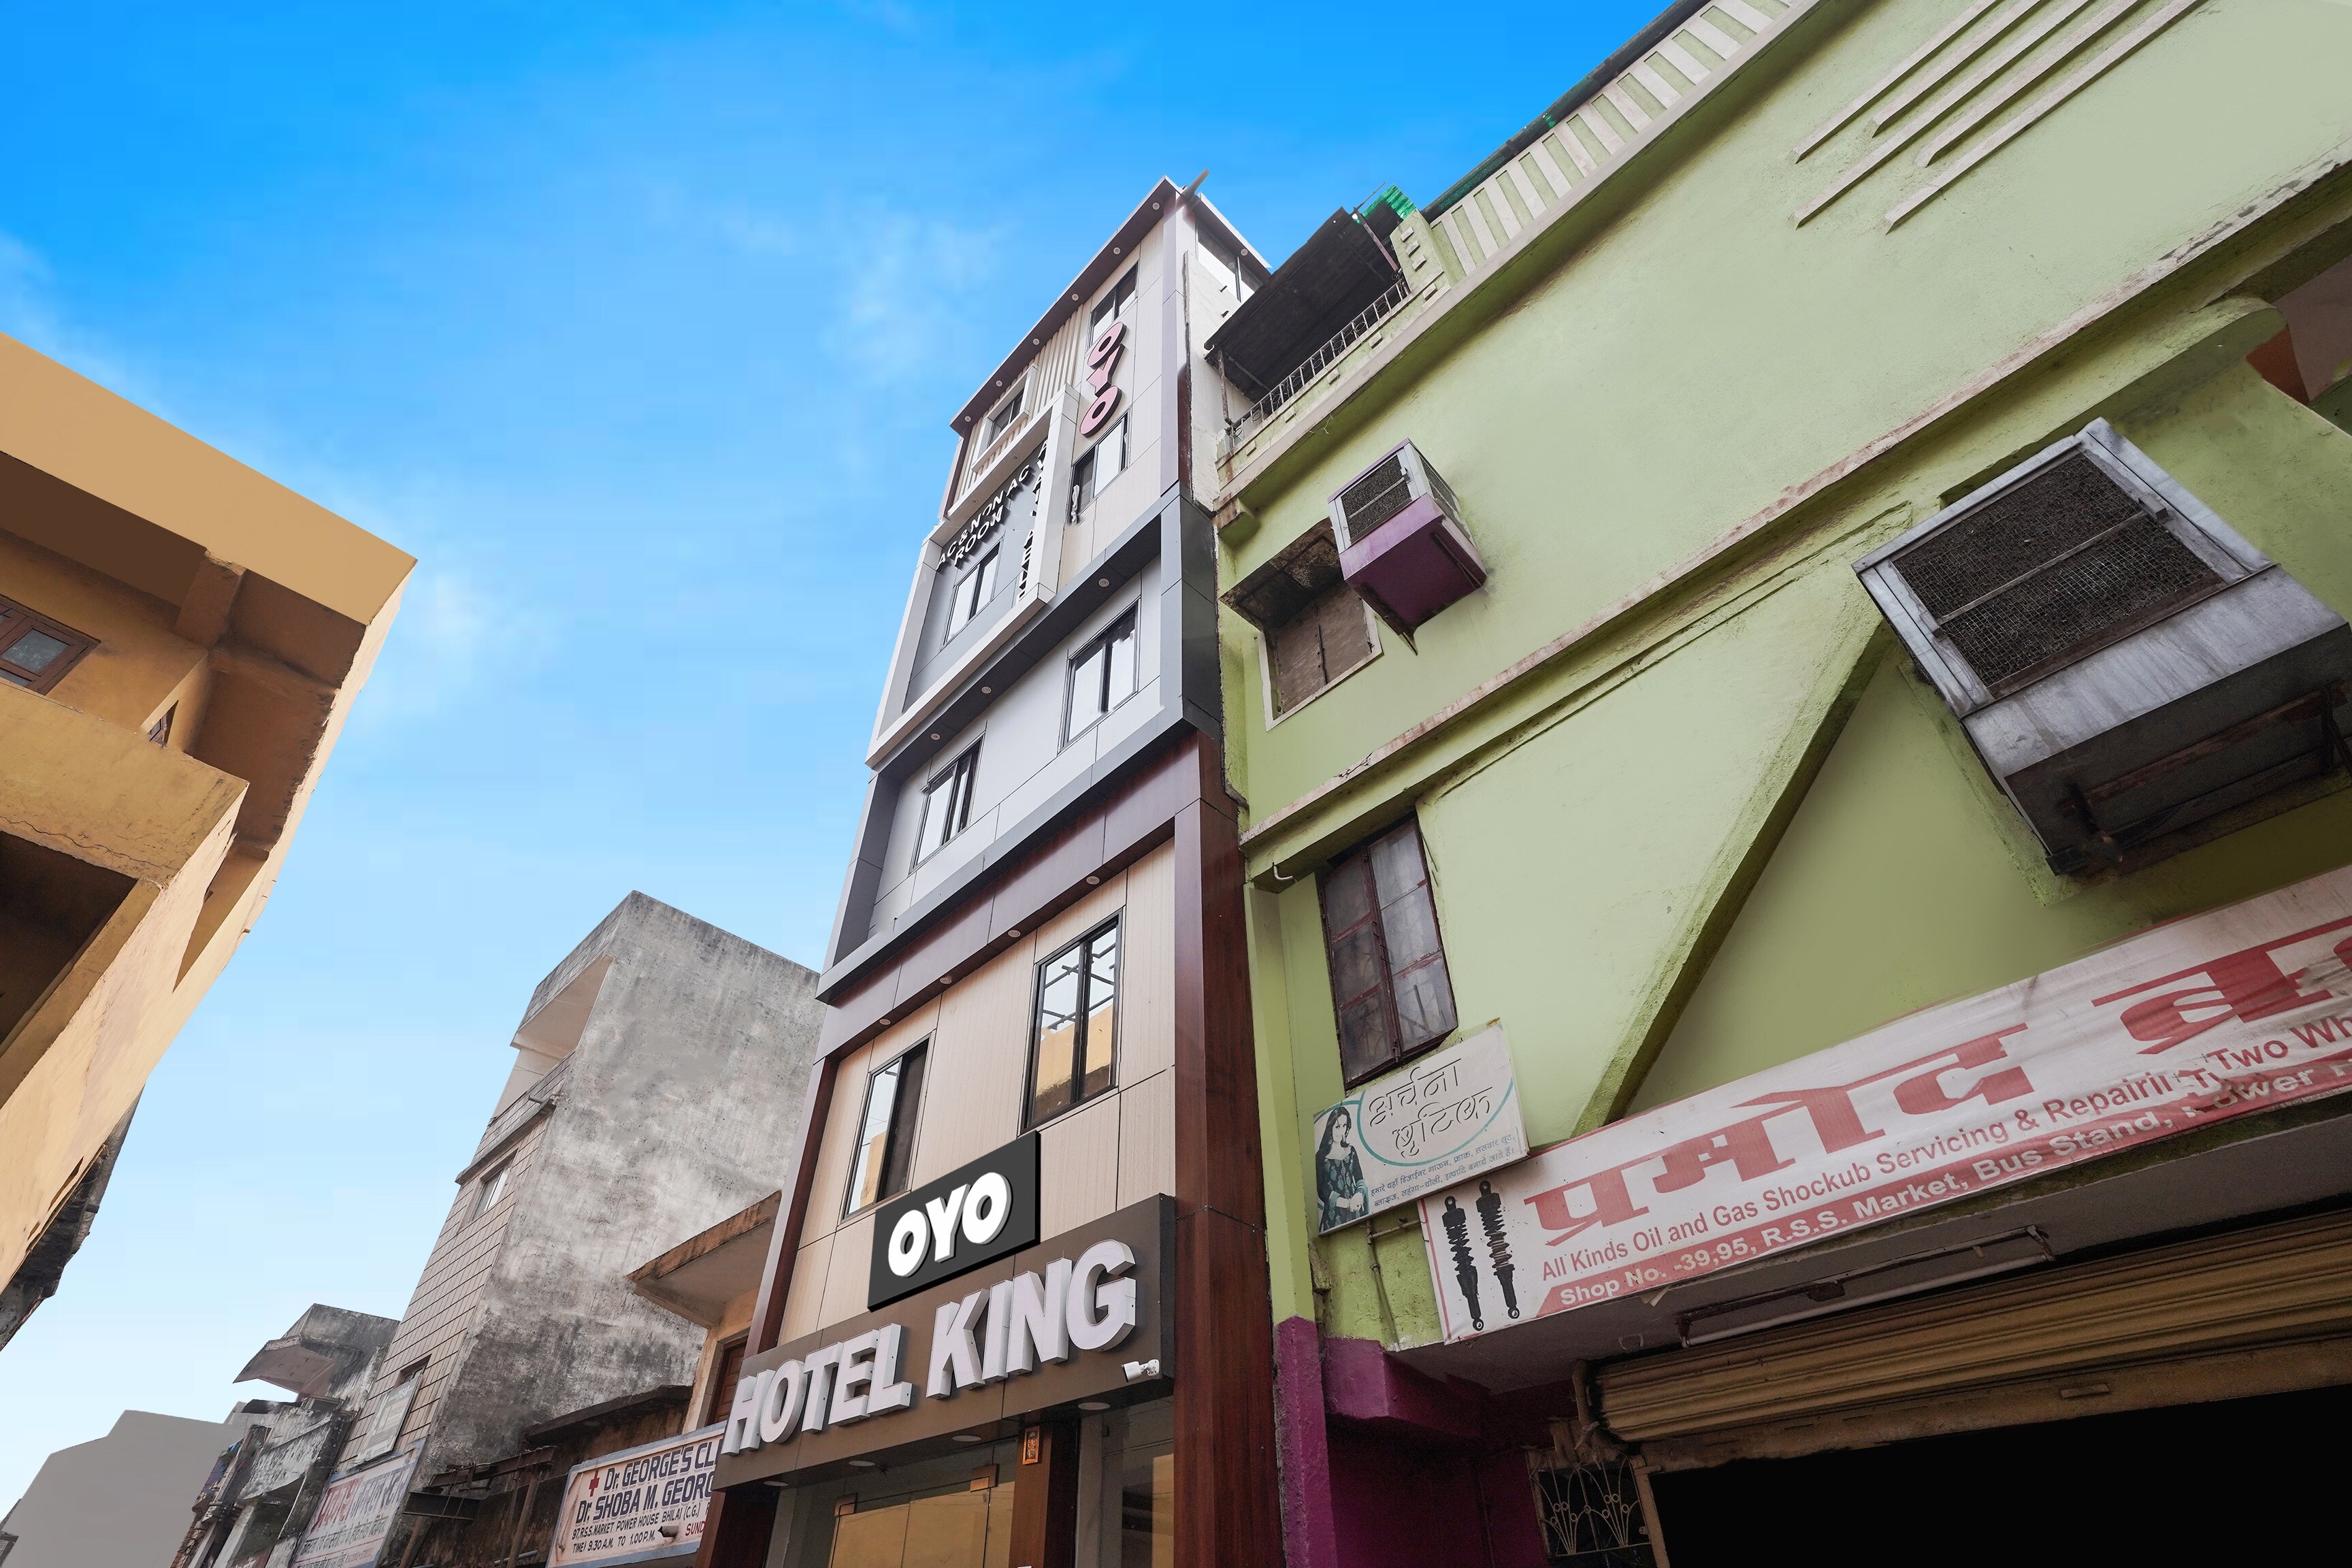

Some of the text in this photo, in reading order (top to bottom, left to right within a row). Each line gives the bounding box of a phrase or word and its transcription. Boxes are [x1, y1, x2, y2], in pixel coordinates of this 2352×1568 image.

[1079, 322, 1127, 438] OYO
[936, 541, 957, 570] AC
[970, 490, 1004, 534] NON
[1006, 465, 1030, 497] AC
[954, 505, 1004, 566] ROOM
[1542, 1256, 1567, 1281] All
[1570, 1241, 1628, 1273] Kinds
[1633, 1226, 1663, 1252] Oil
[1667, 1212, 1708, 1242] and
[1713, 1202, 1759, 1226] Gas
[1763, 1162, 1871, 1211] Shockub
[1876, 1122, 2009, 1174] Servicing
[2014, 1109, 2040, 1132] &
[2206, 1040, 2289, 1070] Two
[1559, 1279, 1620, 1305] Shop
[1625, 1267, 1667, 1287] No.
[1761, 1211, 1848, 1247] R.S.S.
[1852, 1173, 1968, 1220] Market,
[1972, 1149, 2043, 1181] Bus
[2048, 1111, 2174, 1156] Stand,
[888, 1172, 1011, 1277] OYO
[721, 1239, 1136, 1456] HOTEL KING
[576, 1500, 592, 1524] Dr.
[593, 1488, 640, 1520] SHOBA
[643, 1484, 658, 1510] M.
[604, 1468, 620, 1490] Dr.
[622, 1446, 693, 1487] GEORGE'S
[616, 1518, 637, 1531] POWER
[638, 1513, 659, 1527] HOUSE
[662, 1507, 683, 1523] BHILAI
[618, 1536, 625, 1547] TO
